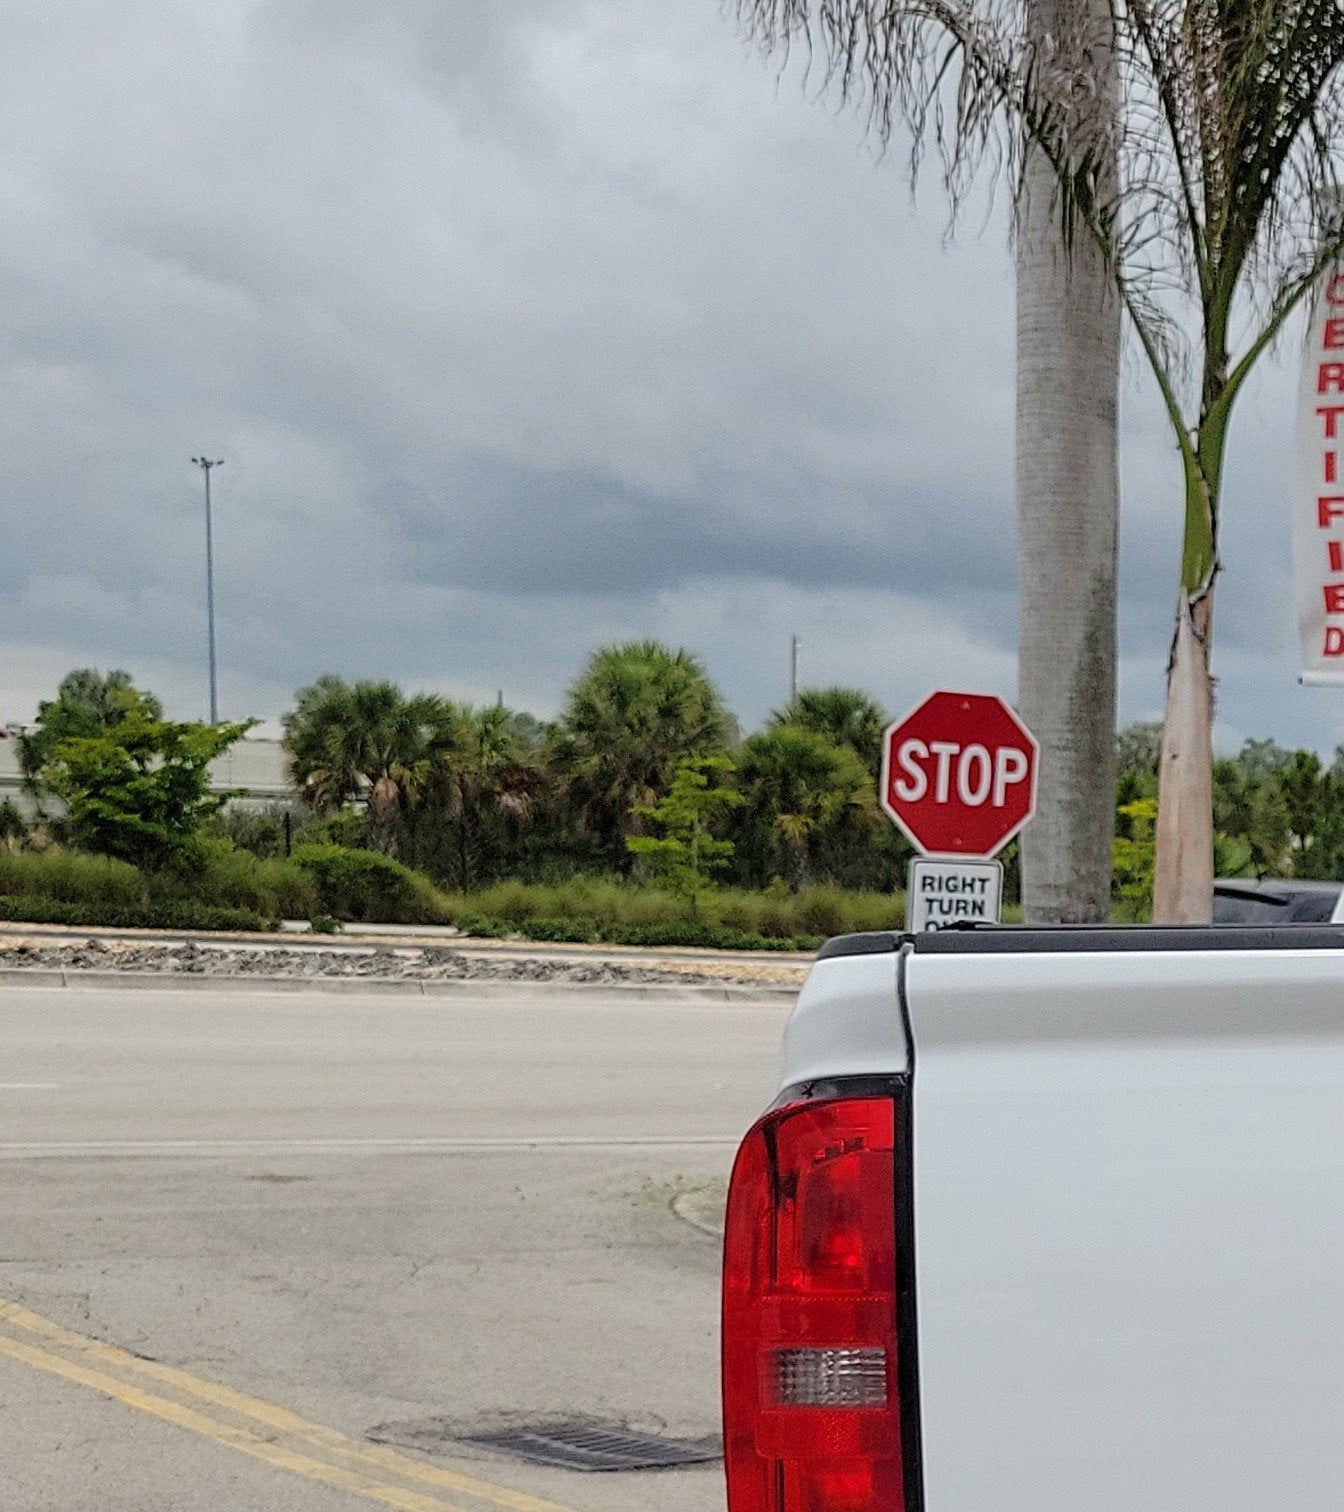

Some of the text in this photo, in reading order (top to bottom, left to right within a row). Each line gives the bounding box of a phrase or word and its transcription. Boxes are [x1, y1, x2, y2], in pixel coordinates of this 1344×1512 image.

[893, 738, 1028, 807] STOP
[921, 875, 991, 893] RIGHT
[926, 897, 985, 916] TURN
